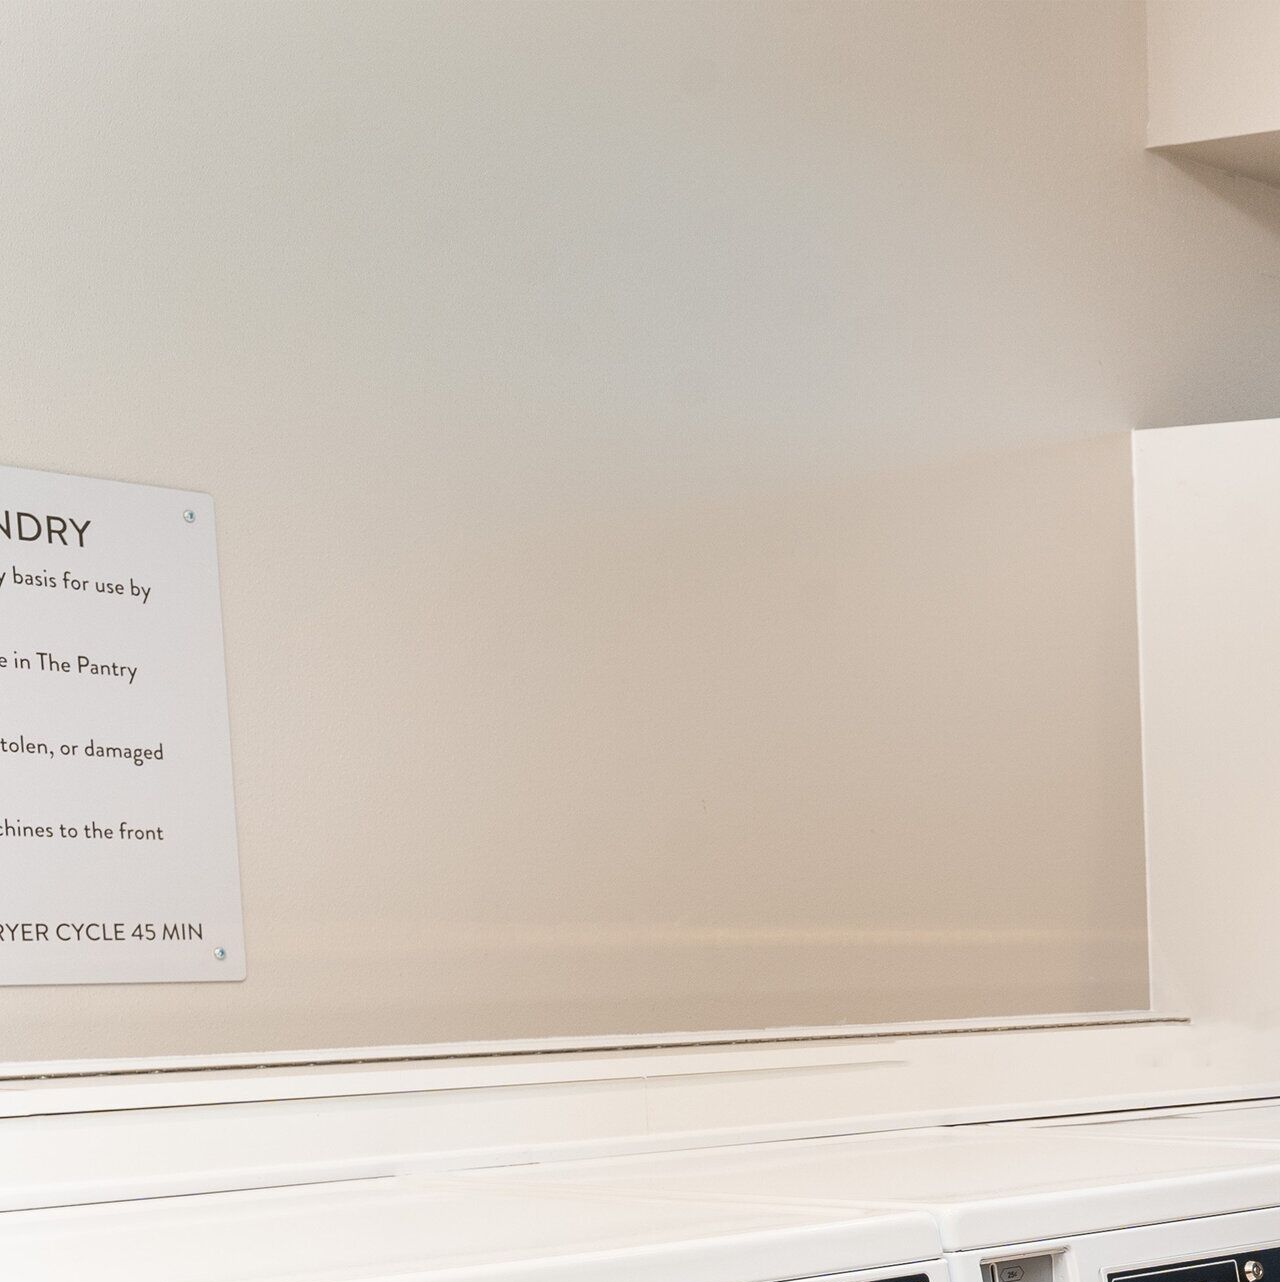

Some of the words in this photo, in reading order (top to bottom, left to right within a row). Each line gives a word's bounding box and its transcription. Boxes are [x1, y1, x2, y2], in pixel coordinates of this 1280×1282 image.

[12, 565, 57, 589] basis
[62, 571, 90, 592] for
[95, 580, 125, 596] use
[130, 579, 152, 605] by
[13, 650, 31, 670] in
[36, 651, 71, 674] The
[77, 655, 138, 685] Pantry
[60, 742, 79, 758] or
[84, 740, 165, 767] damaged
[59, 823, 79, 839] to
[84, 822, 115, 840] the
[119, 821, 165, 842] front
[56, 922, 125, 942] CYCLE
[131, 923, 157, 942] 45
[162, 922, 203, 942] MIN
